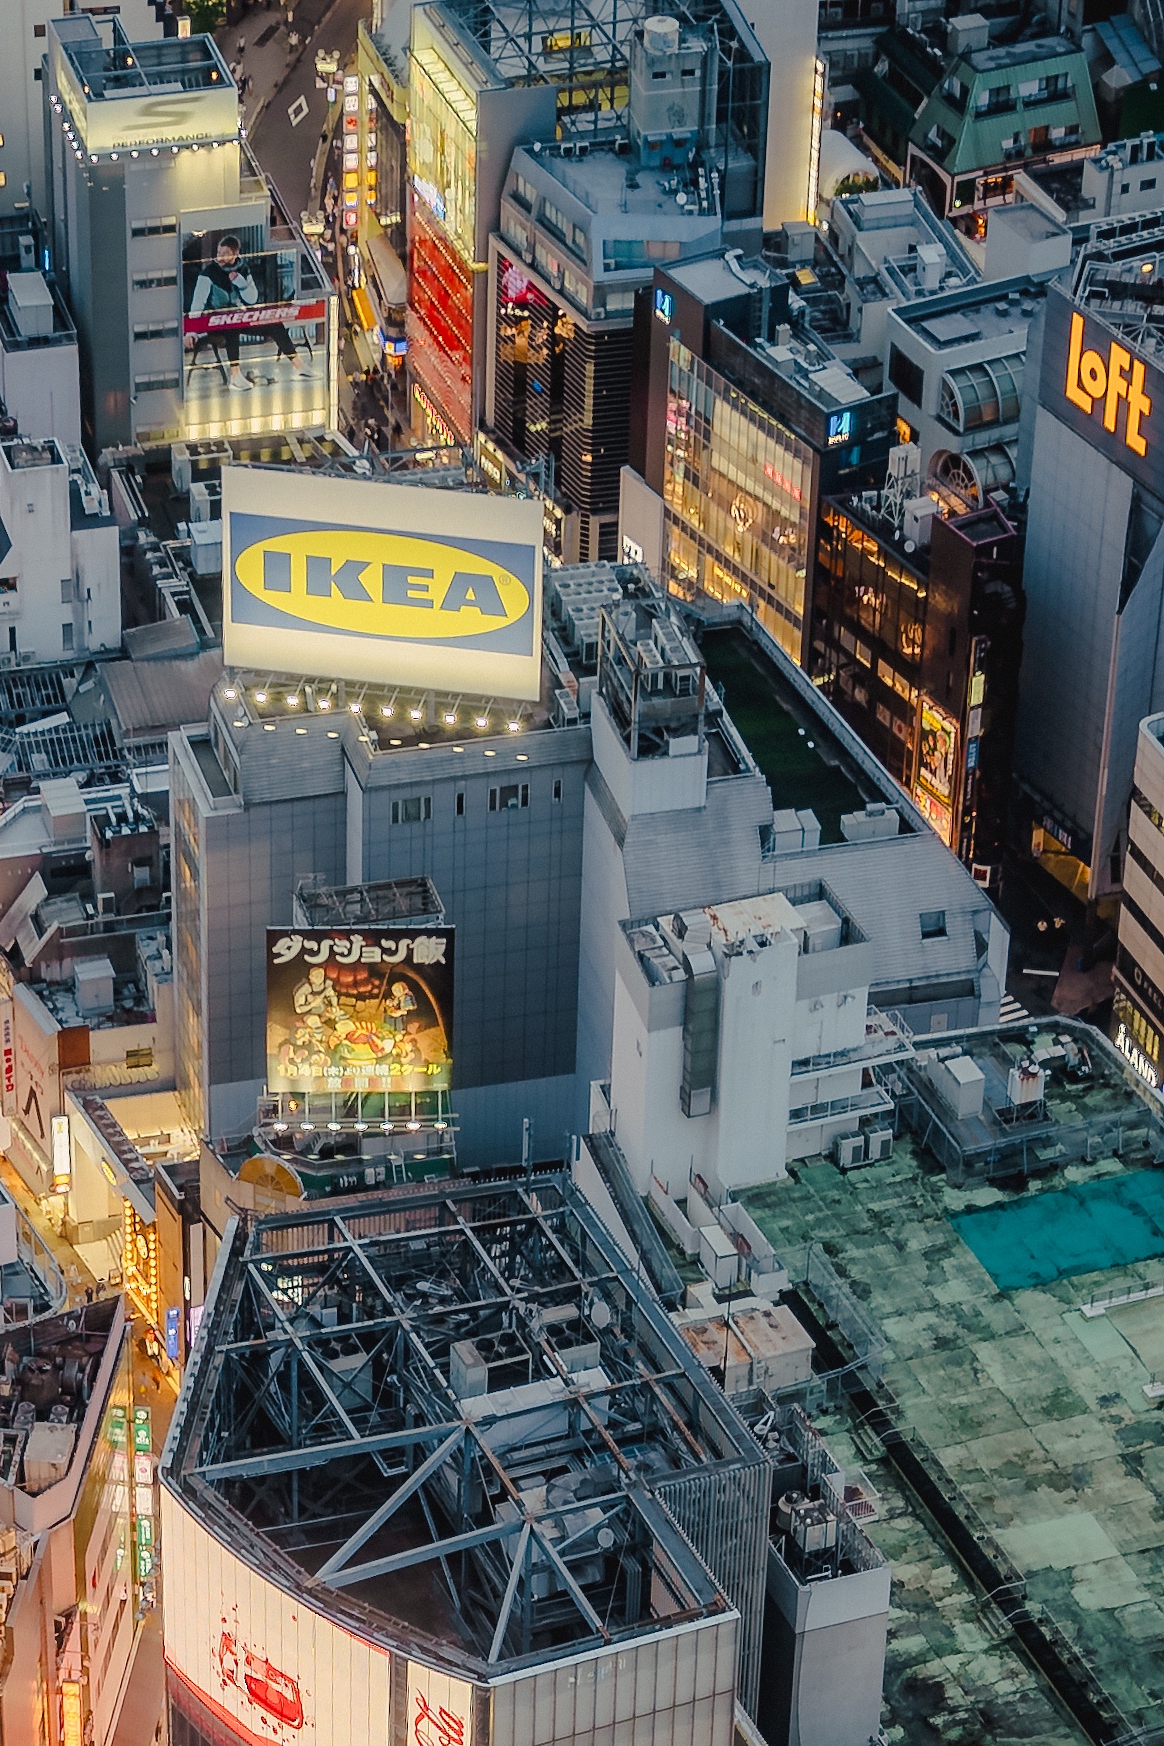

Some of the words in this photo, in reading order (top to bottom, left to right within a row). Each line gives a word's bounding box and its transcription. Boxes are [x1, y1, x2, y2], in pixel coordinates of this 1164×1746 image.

[113, 132, 212, 149] PERFORMANCE
[209, 306, 300, 326] SKECHERS
[263, 550, 508, 618] IKEA
[272, 934, 447, 965] ダンジョン飯
